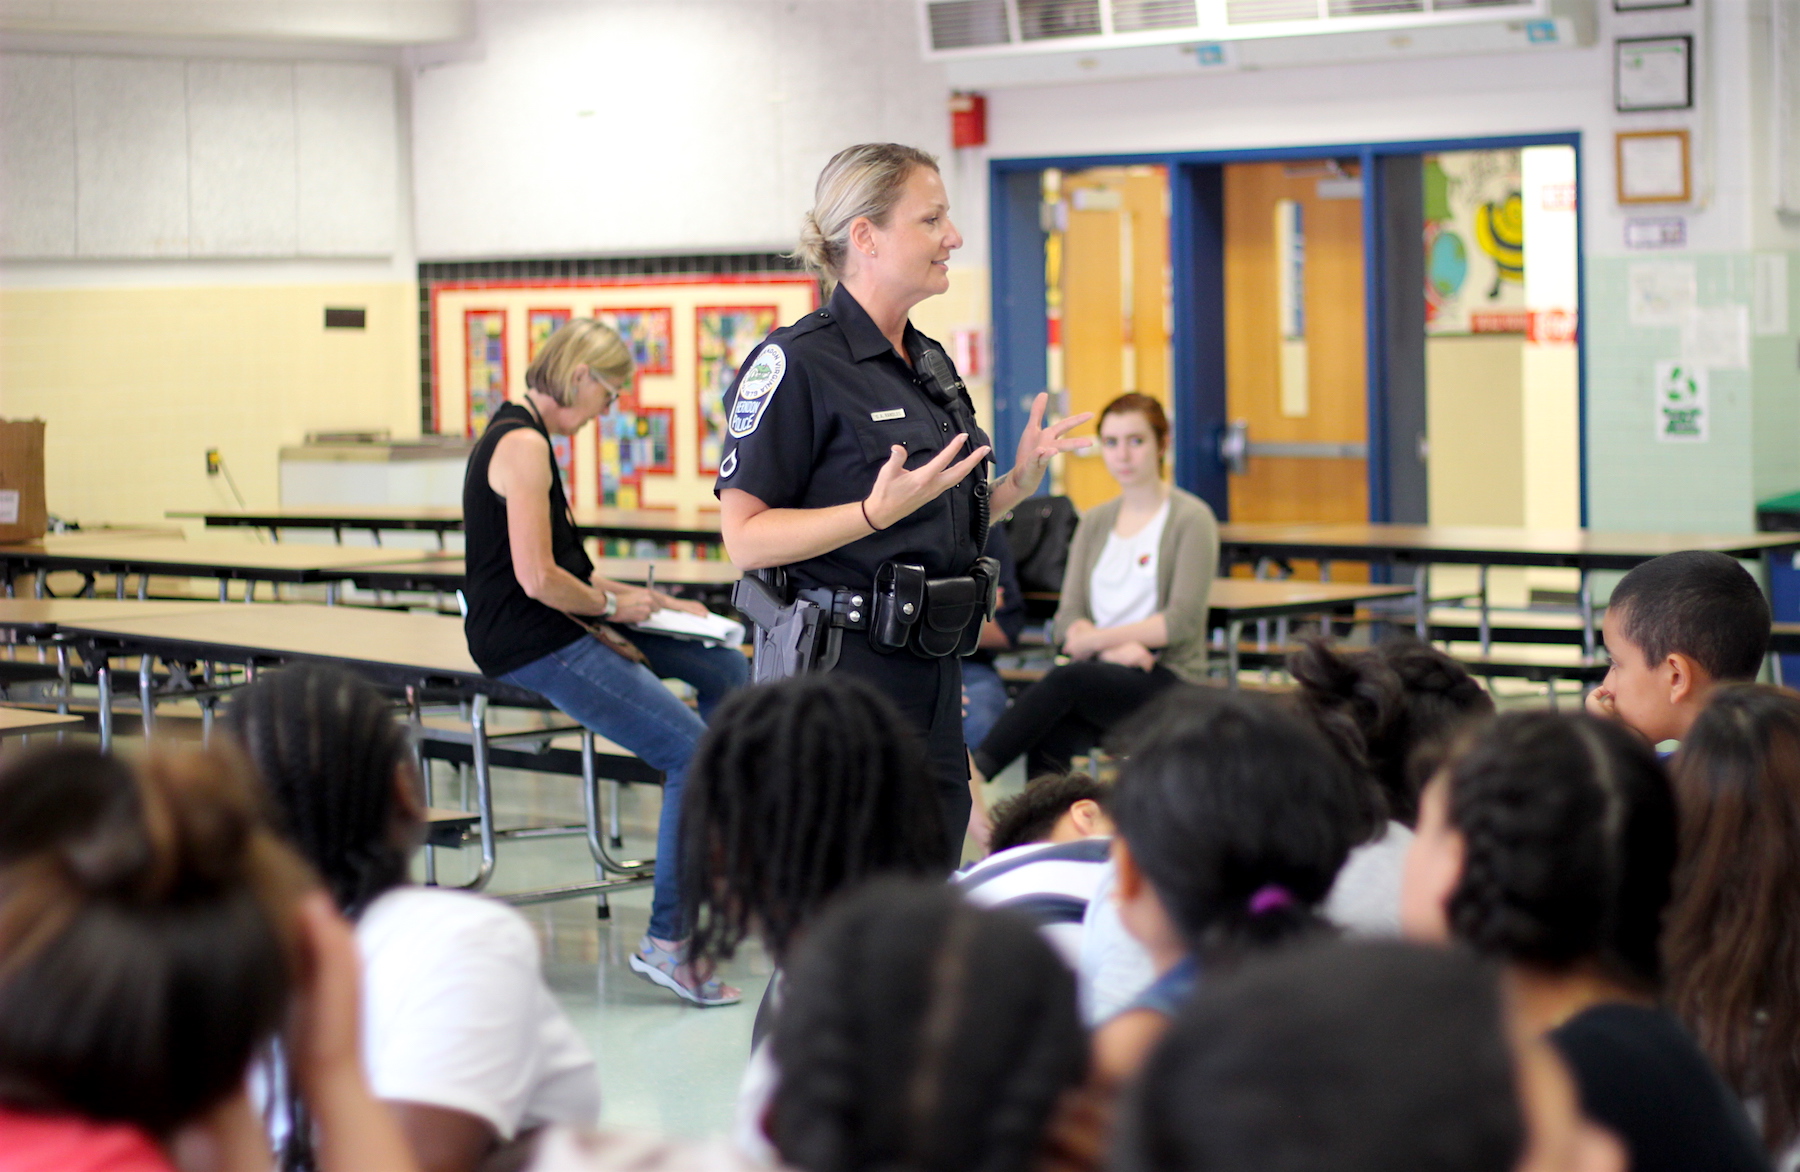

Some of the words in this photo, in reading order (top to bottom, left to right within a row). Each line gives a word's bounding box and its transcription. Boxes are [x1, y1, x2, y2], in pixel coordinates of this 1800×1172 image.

[760, 361, 781, 393] VIRGINIA
[735, 401, 761, 414] HERNDON
[732, 413, 755, 432] POLICE
